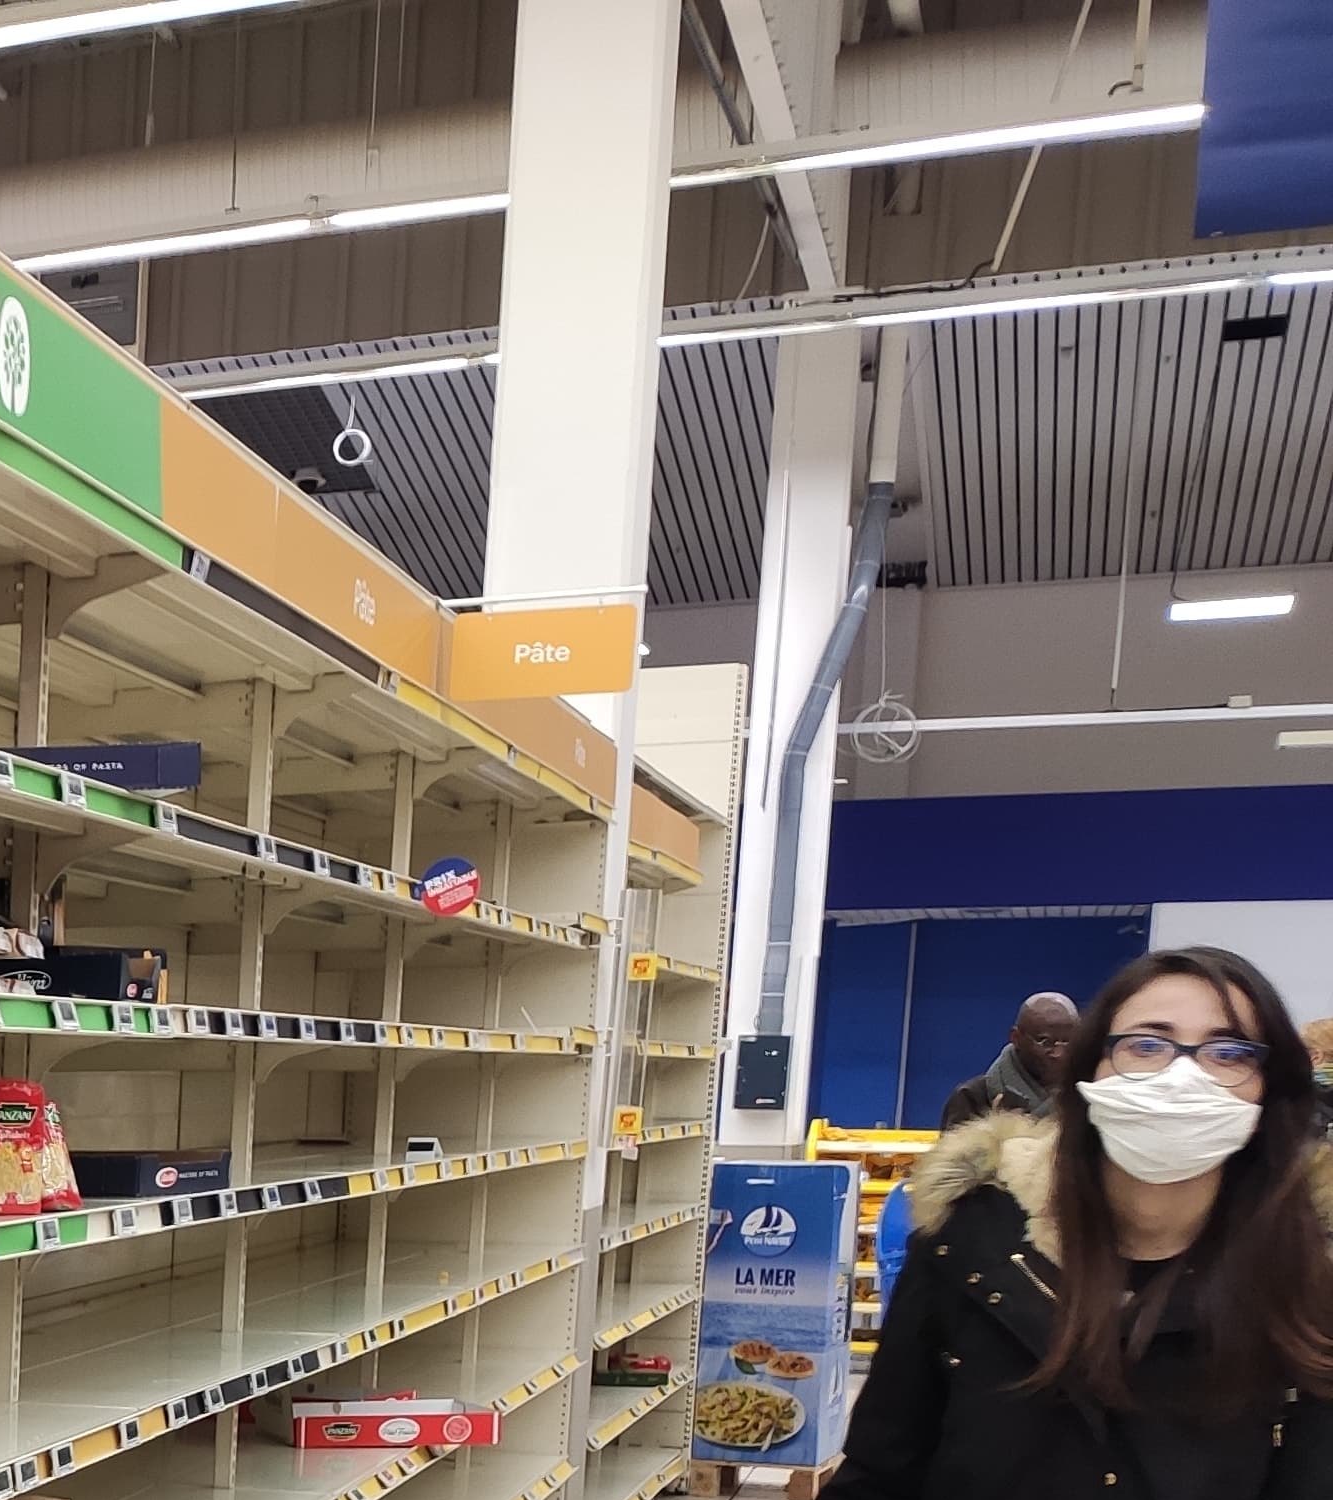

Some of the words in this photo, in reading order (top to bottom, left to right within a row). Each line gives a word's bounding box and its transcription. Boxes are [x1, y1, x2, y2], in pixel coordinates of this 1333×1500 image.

[514, 641, 571, 664] Pâte
[91, 762, 124, 771] PASTA
[735, 1267, 754, 1286] LA
[760, 1268, 796, 1286] MER
